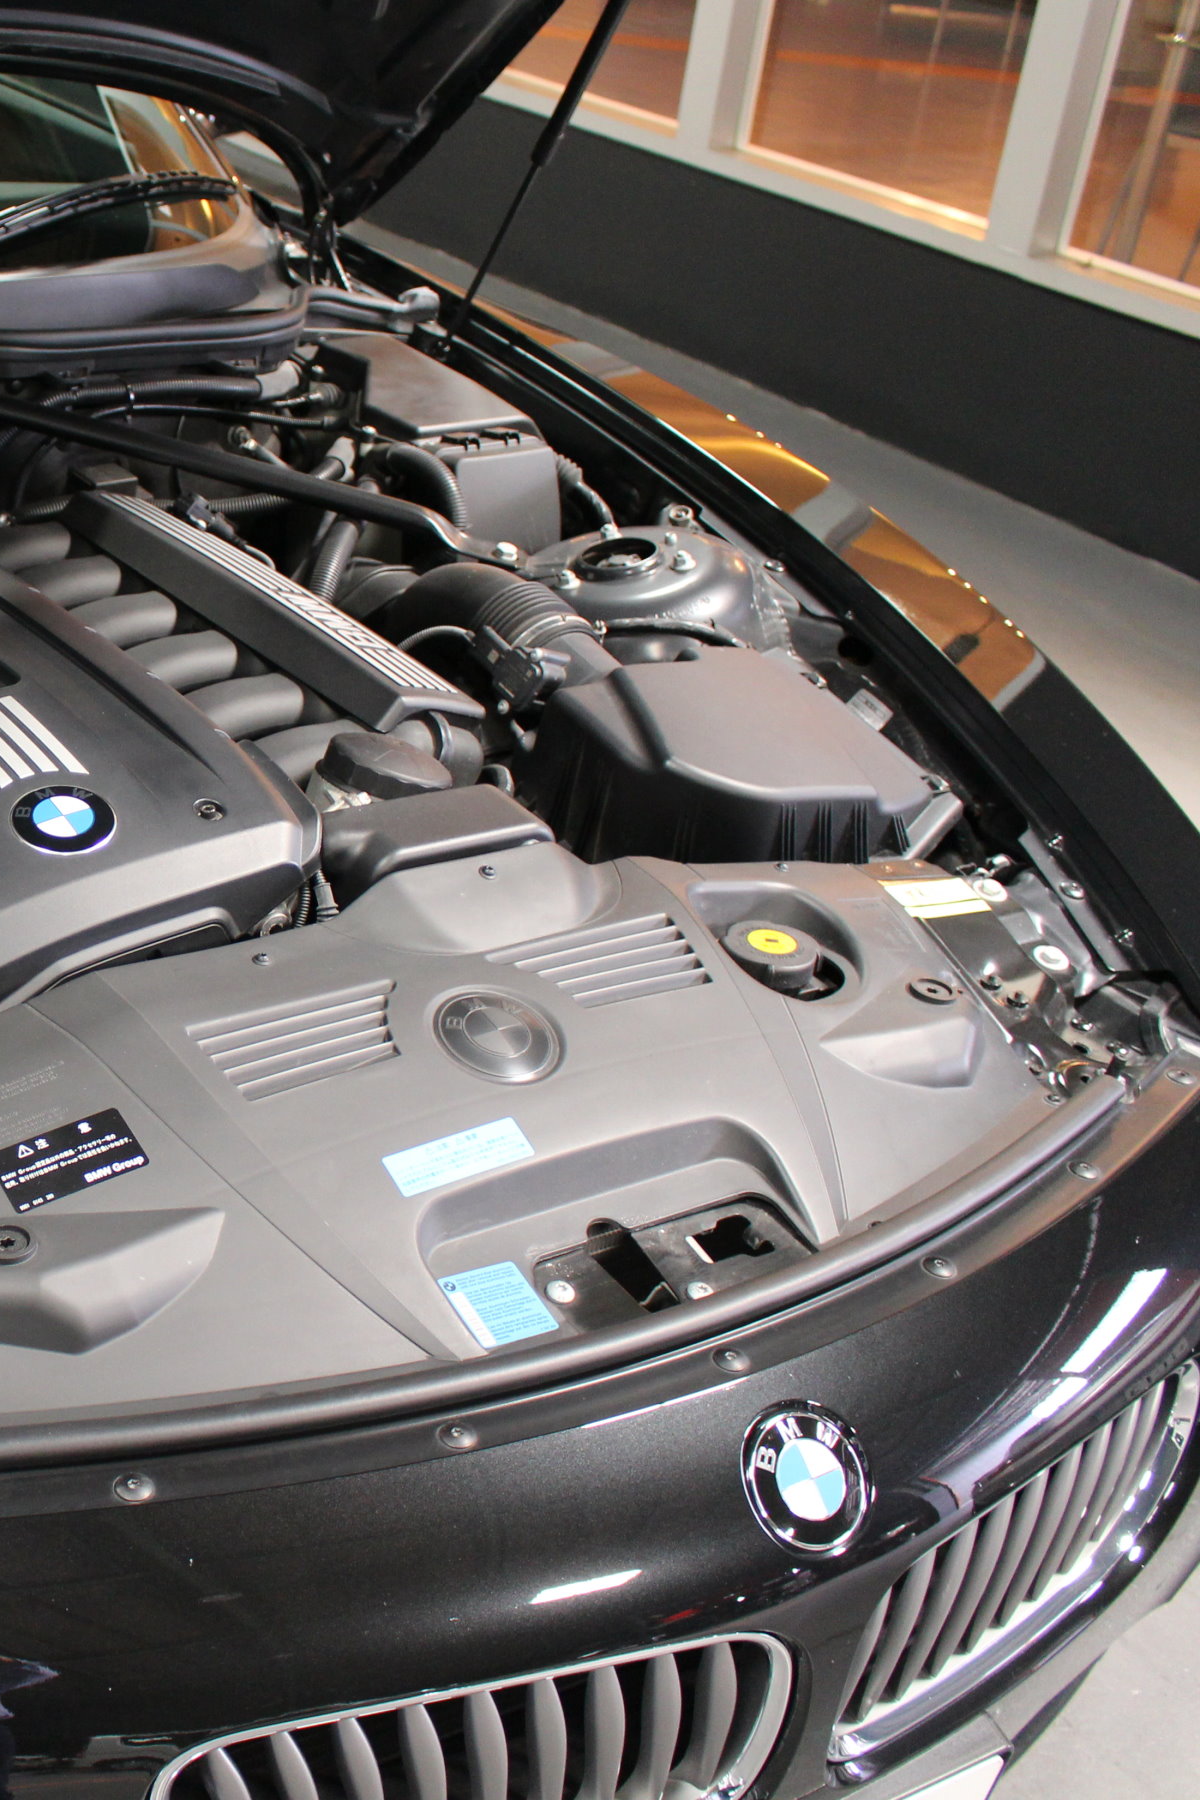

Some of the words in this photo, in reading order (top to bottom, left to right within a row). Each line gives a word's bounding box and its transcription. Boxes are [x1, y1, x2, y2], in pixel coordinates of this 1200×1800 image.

[15, 787, 94, 818] BMW
[445, 998, 522, 1030] BMW
[83, 1165, 112, 1184] BMW
[112, 1155, 145, 1173] Group
[756, 1418, 840, 1473] BMW
